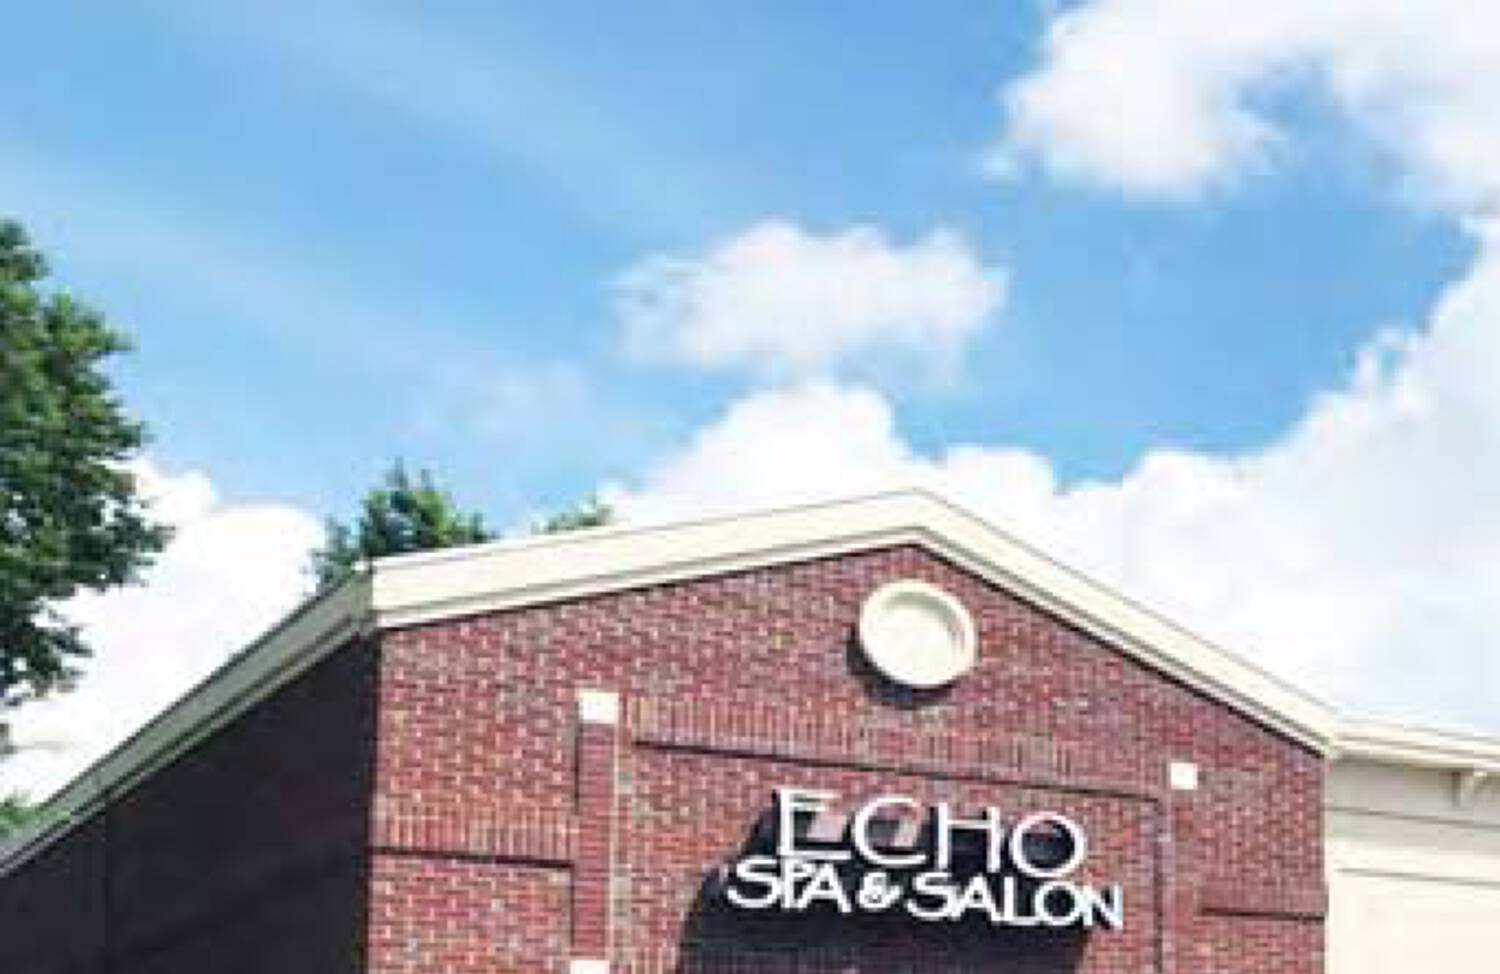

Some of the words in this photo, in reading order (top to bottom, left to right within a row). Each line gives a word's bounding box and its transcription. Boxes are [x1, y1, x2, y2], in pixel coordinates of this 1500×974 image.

[776, 787, 1087, 879] ECHO
[727, 853, 853, 914] SPA
[857, 871, 902, 911] &
[906, 871, 1125, 930] SALON
